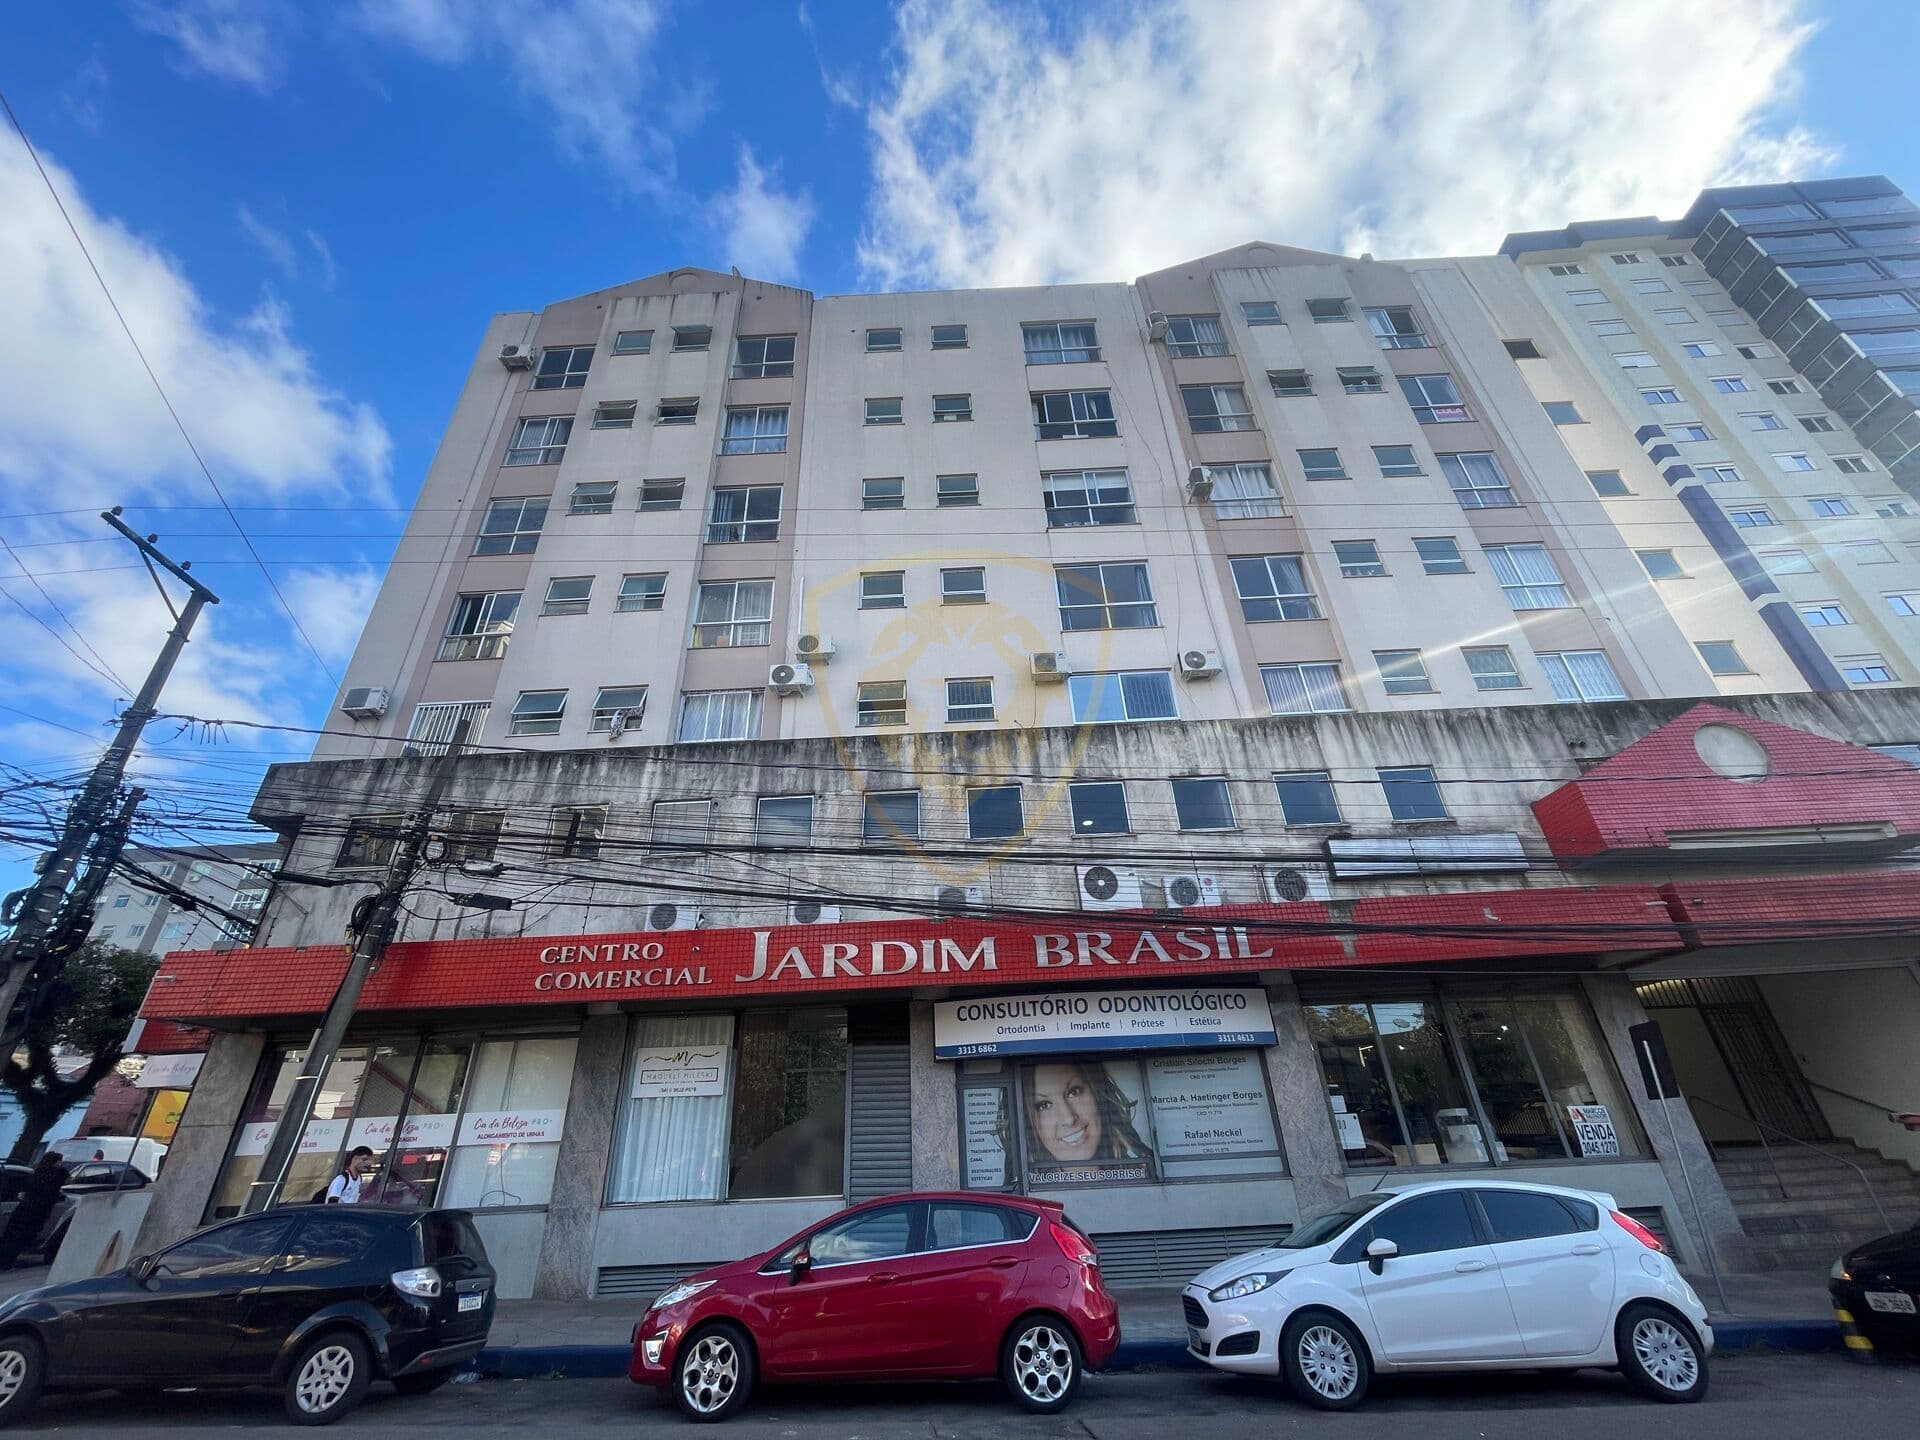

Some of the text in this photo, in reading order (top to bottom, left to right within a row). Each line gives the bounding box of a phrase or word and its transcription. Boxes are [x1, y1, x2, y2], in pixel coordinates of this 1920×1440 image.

[540, 942, 664, 964] CENTRO
[1032, 927, 1274, 968] BRASIL
[534, 966, 712, 991] COMERCIAL
[956, 990, 1247, 1022] CONSULTÓRIO ODONTOLÓGICO
[997, 1017, 1222, 1035] Ortodontia Implante Prótese Estética
[1218, 1034, 1236, 1042] 3311
[957, 1044, 997, 1055] 3313 6862
[1232, 1091, 1263, 1100] Borges
[1184, 1128, 1242, 1139] Rafael Neckel
[1576, 1124, 1615, 1140] VENDA
[1029, 1172, 1075, 1183] VALORIZE
[1077, 1171, 1097, 1180] SEU
